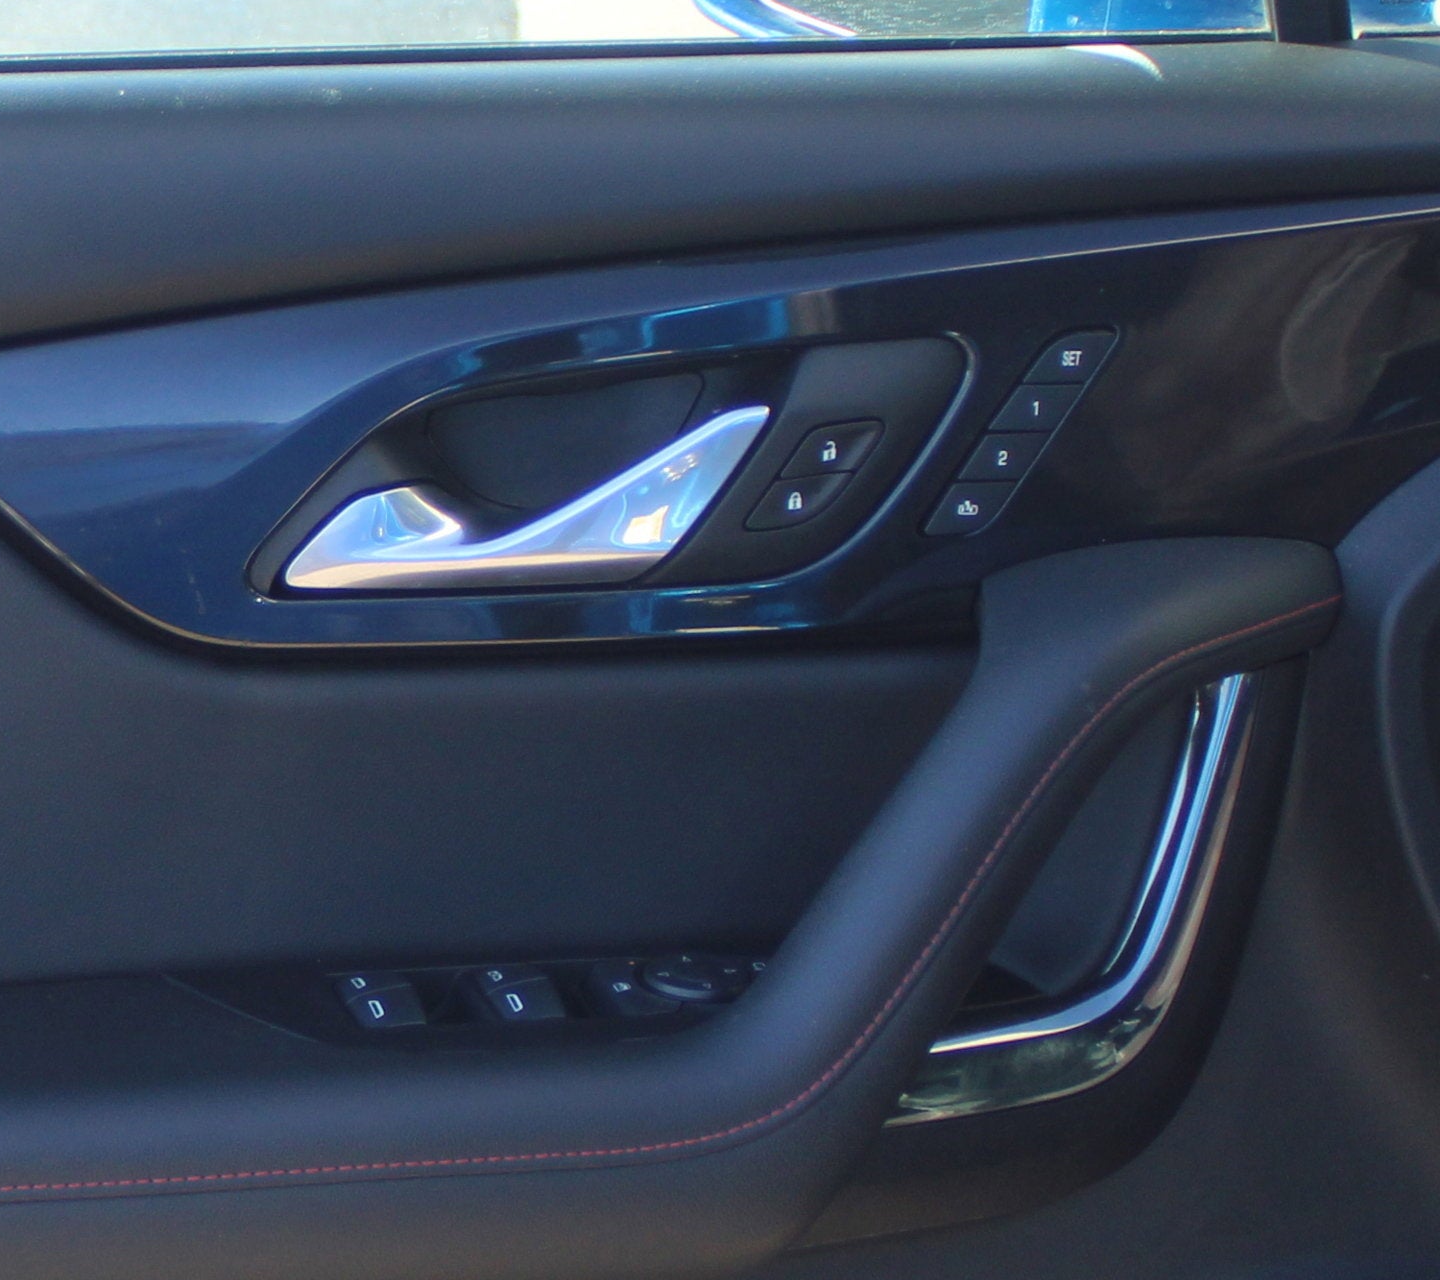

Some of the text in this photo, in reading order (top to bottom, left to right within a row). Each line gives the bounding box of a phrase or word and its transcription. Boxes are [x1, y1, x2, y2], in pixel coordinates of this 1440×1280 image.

[1061, 350, 1083, 367] SET
[1032, 400, 1040, 416] 1
[997, 449, 1009, 467] 2
